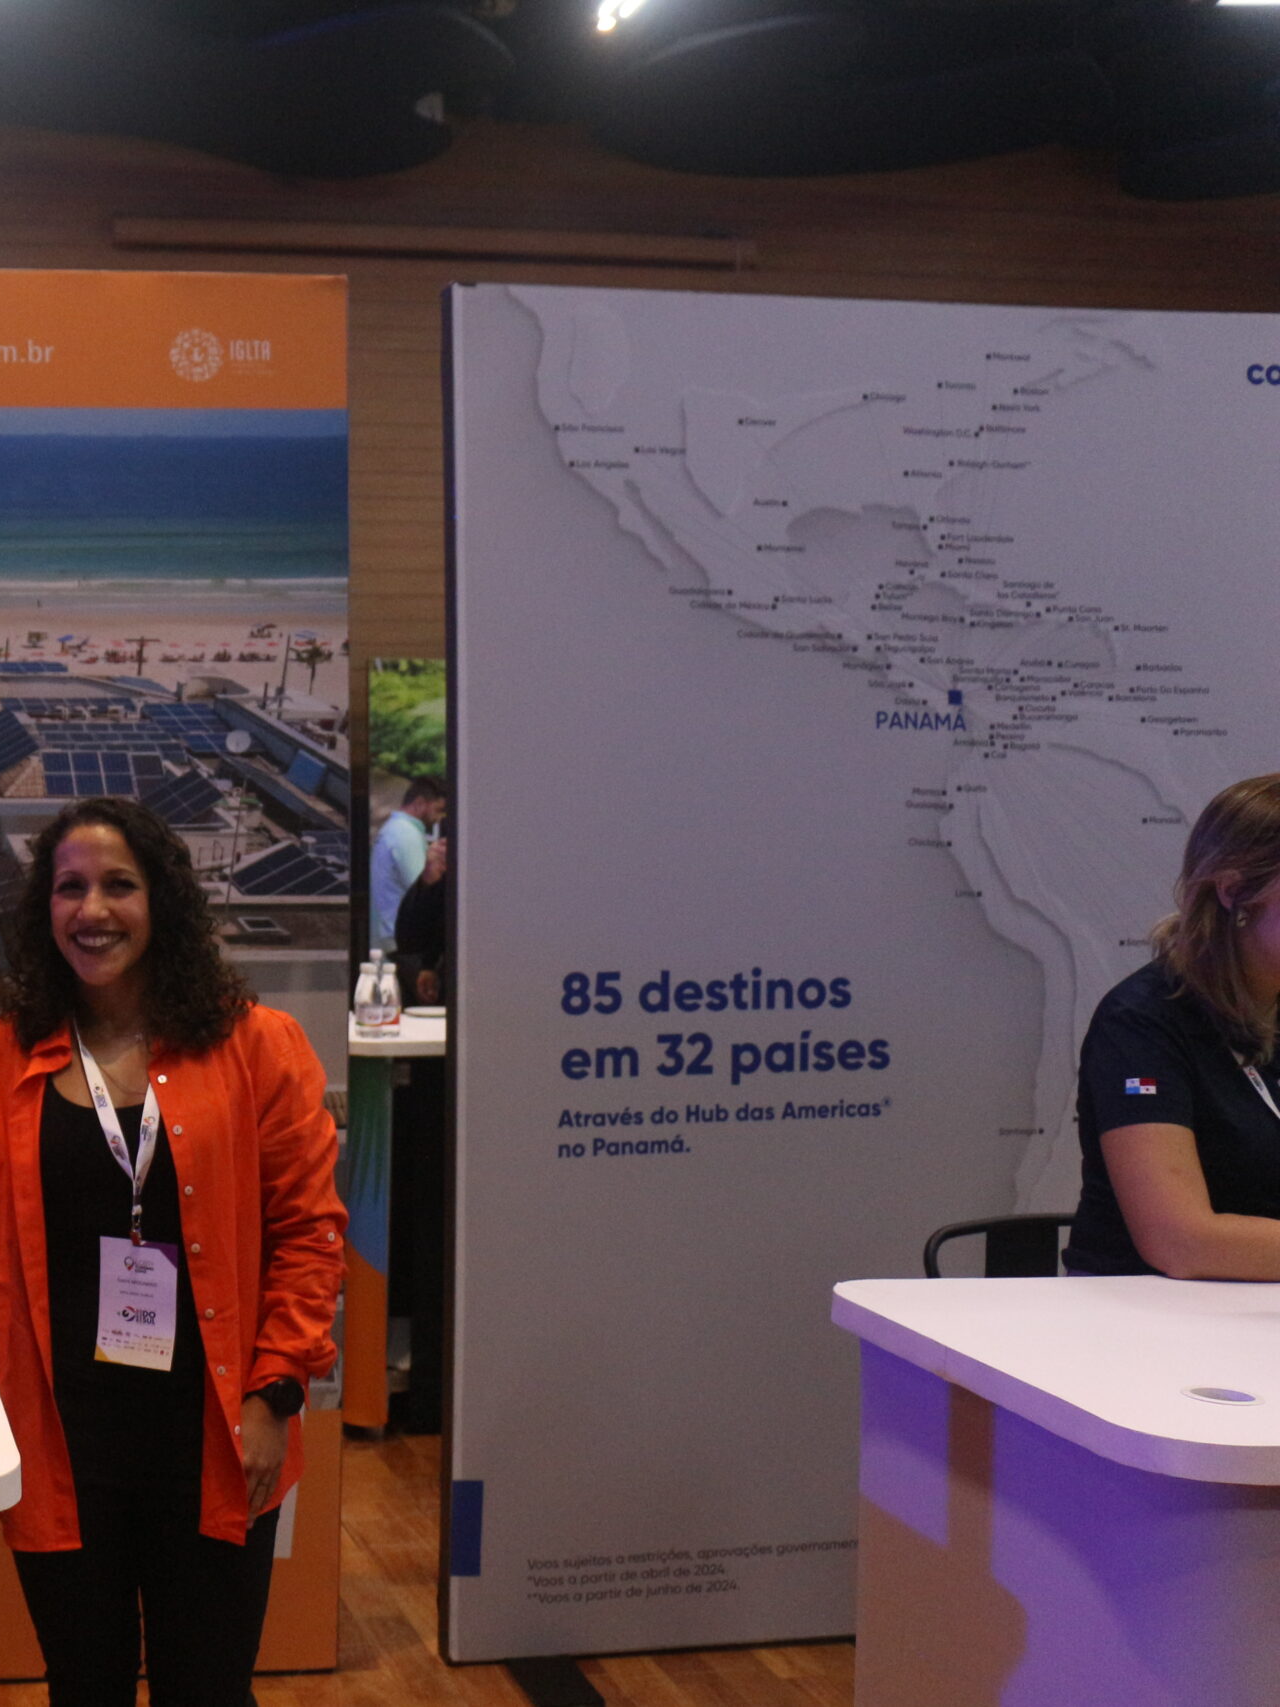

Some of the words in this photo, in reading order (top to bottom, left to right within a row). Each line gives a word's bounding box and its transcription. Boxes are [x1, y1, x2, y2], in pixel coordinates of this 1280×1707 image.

[945, 380, 977, 390] Toronto
[1020, 386, 1050, 396] Boston
[870, 391, 907, 404] Chicago
[903, 425, 954, 438] Washington
[985, 423, 1027, 434] Baltimore
[936, 514, 971, 524] Orlando
[1142, 662, 1183, 672] Barbados
[1080, 680, 1115, 690] Caracas
[875, 707, 967, 731] PANAMÁ
[560, 971, 622, 1016] 85
[638, 966, 853, 1014] destinos
[560, 1044, 640, 1080] em
[656, 1032, 714, 1077] 32
[730, 1030, 891, 1086] países
[557, 1106, 644, 1129] Através
[650, 1105, 679, 1125] do
[685, 1103, 729, 1124] Hub
[735, 1101, 775, 1122] das
[558, 1143, 585, 1158] no
[592, 1134, 691, 1157] Panamá.
[528, 1559, 559, 1570] Voos
[563, 1555, 612, 1569] sujeitos
[616, 1555, 626, 1565] a
[567, 1575, 577, 1585] a
[580, 1571, 616, 1586] partir
[620, 1569, 638, 1582] de
[640, 1566, 670, 1580] abril
[673, 1566, 691, 1577] de
[572, 1592, 583, 1602] a
[585, 1588, 622, 1605] partir
[625, 1585, 643, 1598] de
[645, 1583, 682, 1599] junho
[685, 1582, 702, 1594] de
